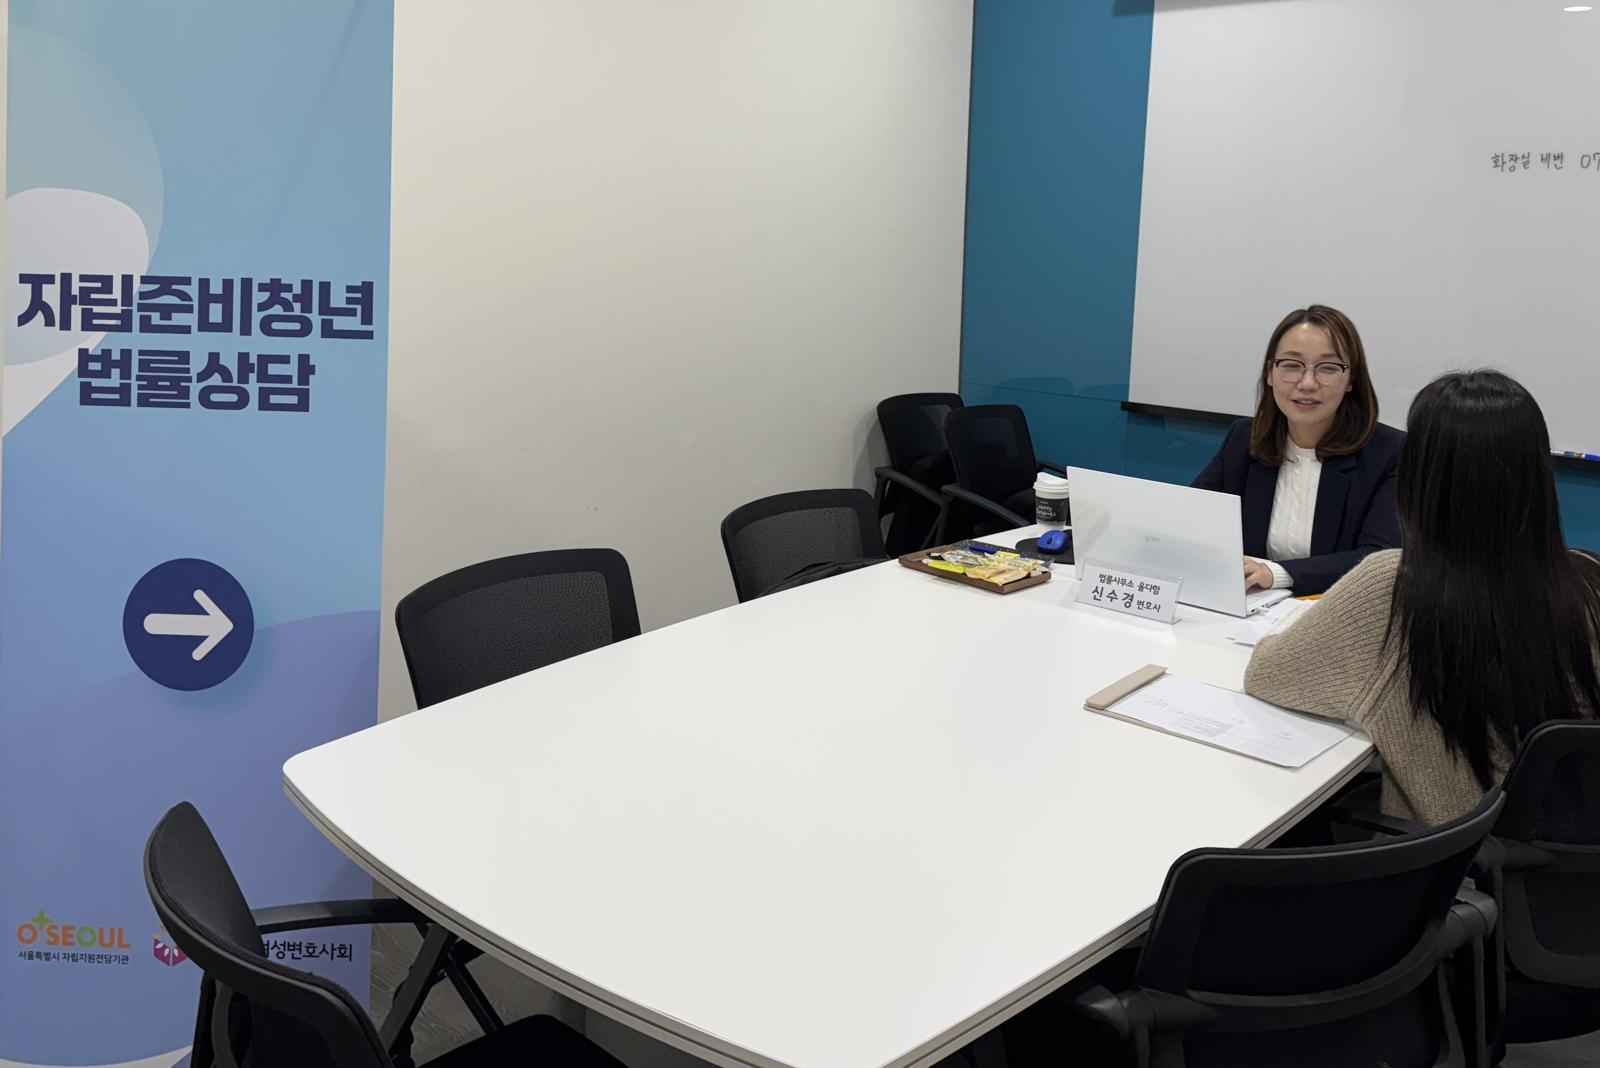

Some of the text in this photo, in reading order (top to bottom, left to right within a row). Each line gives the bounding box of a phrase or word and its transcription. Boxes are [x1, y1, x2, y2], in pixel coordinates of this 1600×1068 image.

[1490, 151, 1530, 172] 화장실
[1539, 151, 1564, 170] 비번
[17, 272, 374, 340] 자립준비청년
[77, 347, 316, 413] 법률상담
[1098, 573, 1134, 588] 법률사무소
[1091, 585, 1161, 613] 신수경 변호사
[18, 950, 129, 966] 서울특별시 자립지원전담기관
